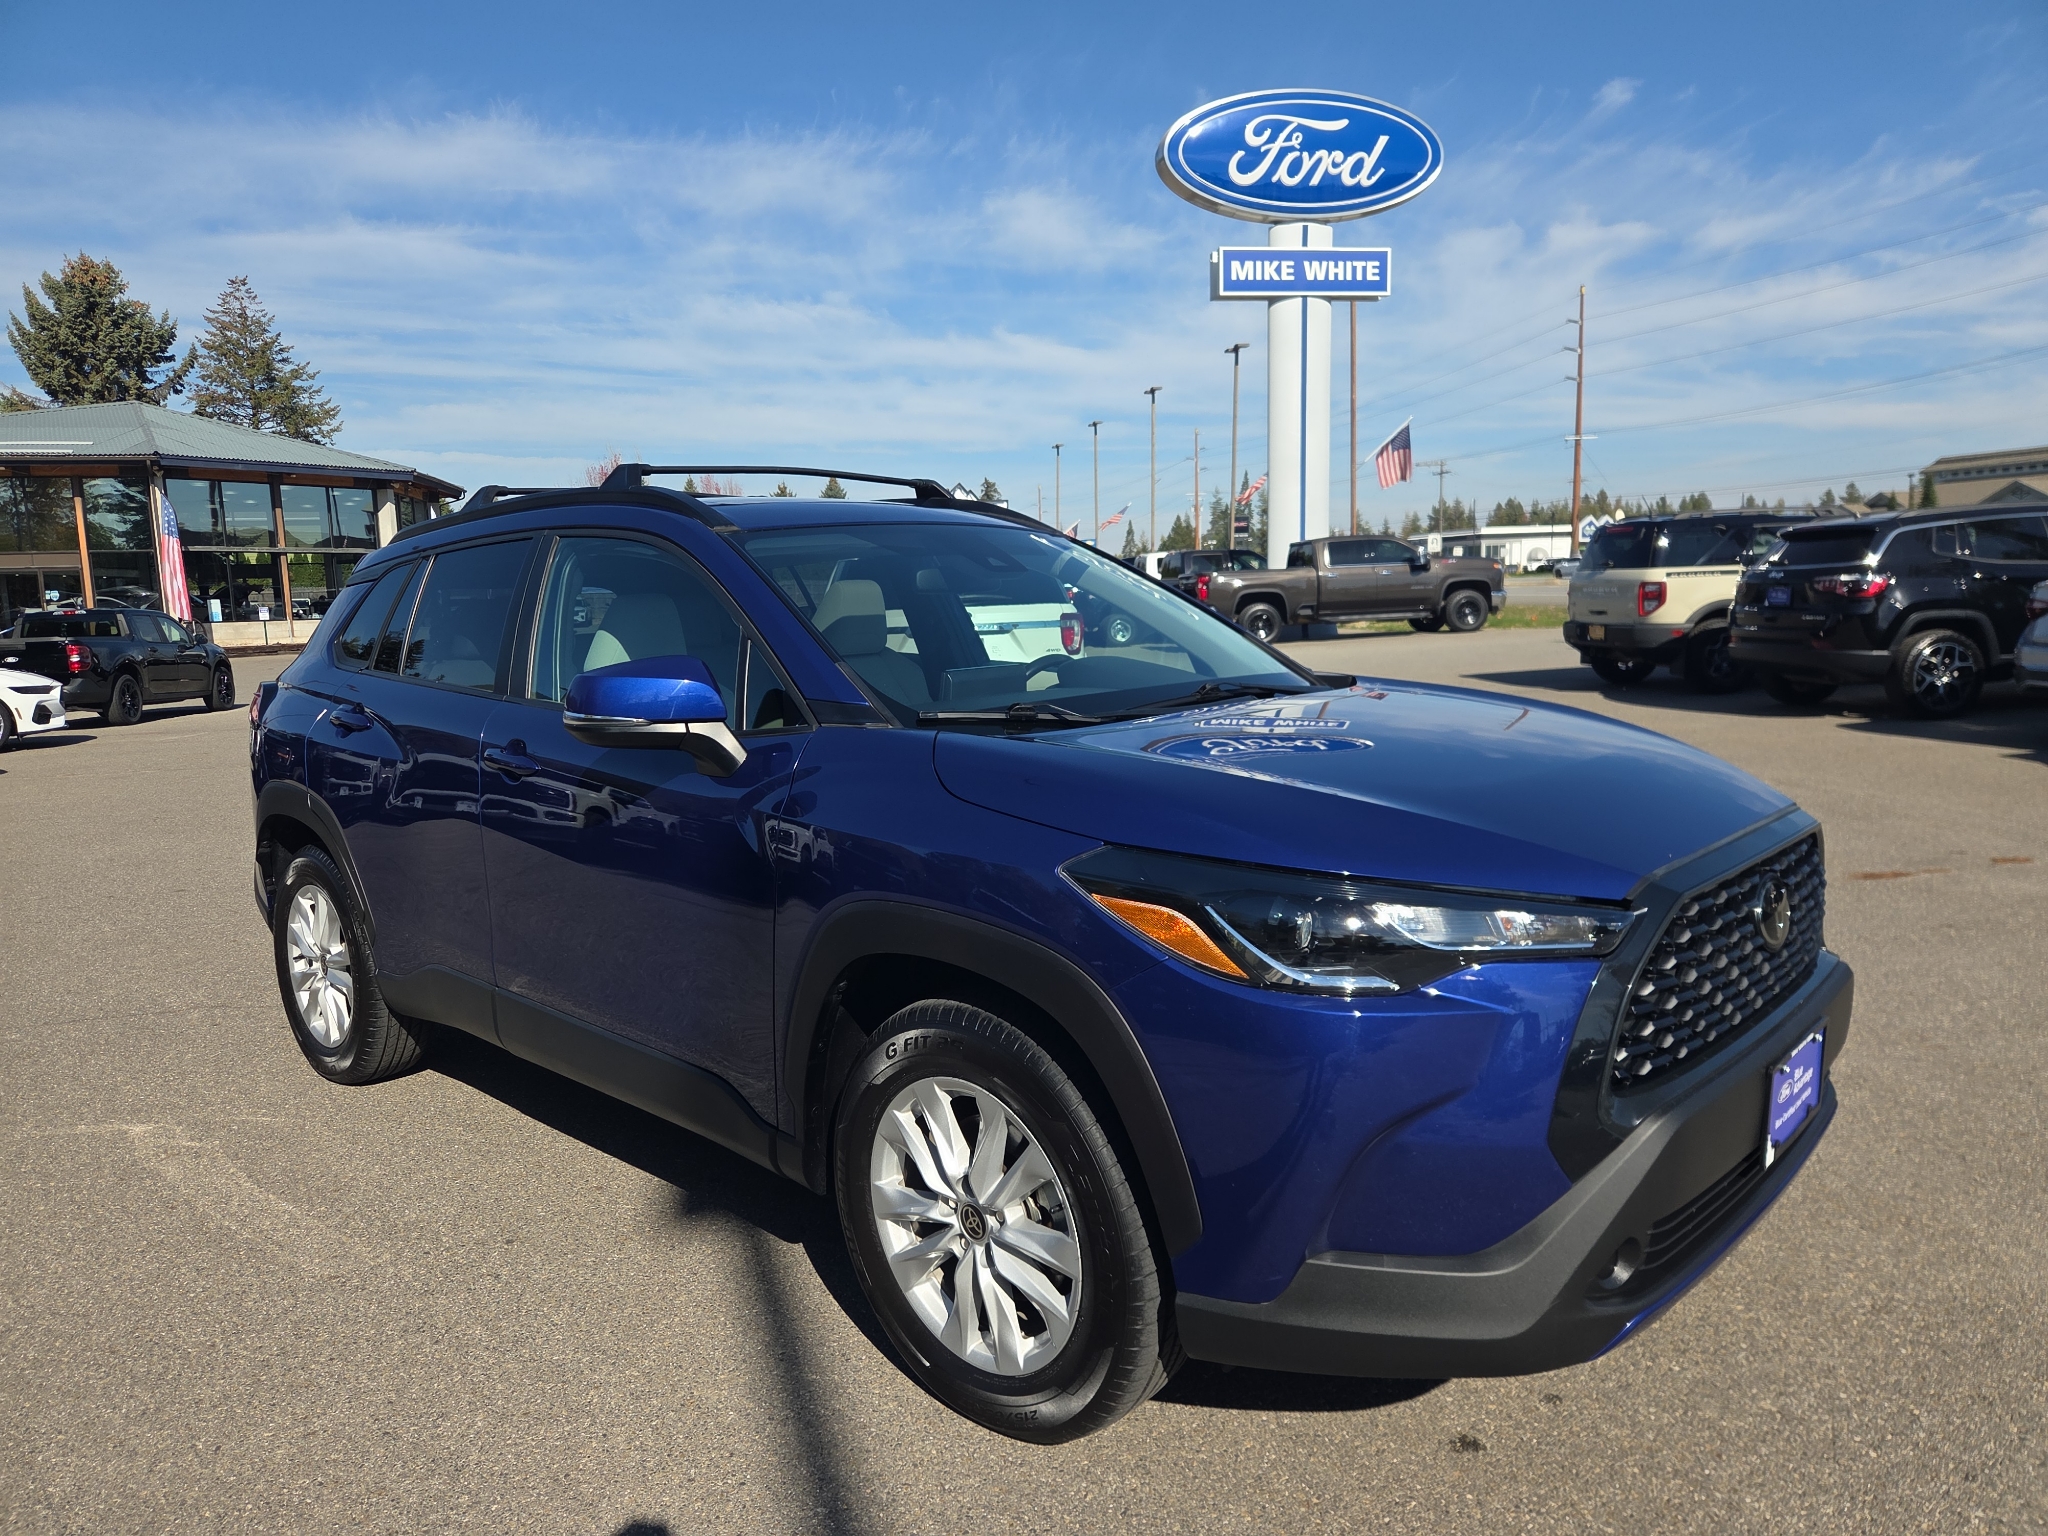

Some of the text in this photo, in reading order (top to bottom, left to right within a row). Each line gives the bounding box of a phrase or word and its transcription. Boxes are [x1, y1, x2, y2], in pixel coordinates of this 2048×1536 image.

[1228, 114, 1390, 187] Ford
[1230, 260, 1381, 281] MIKE WHITE
[885, 1041, 898, 1060] G
[903, 1035, 932, 1053] FIT
